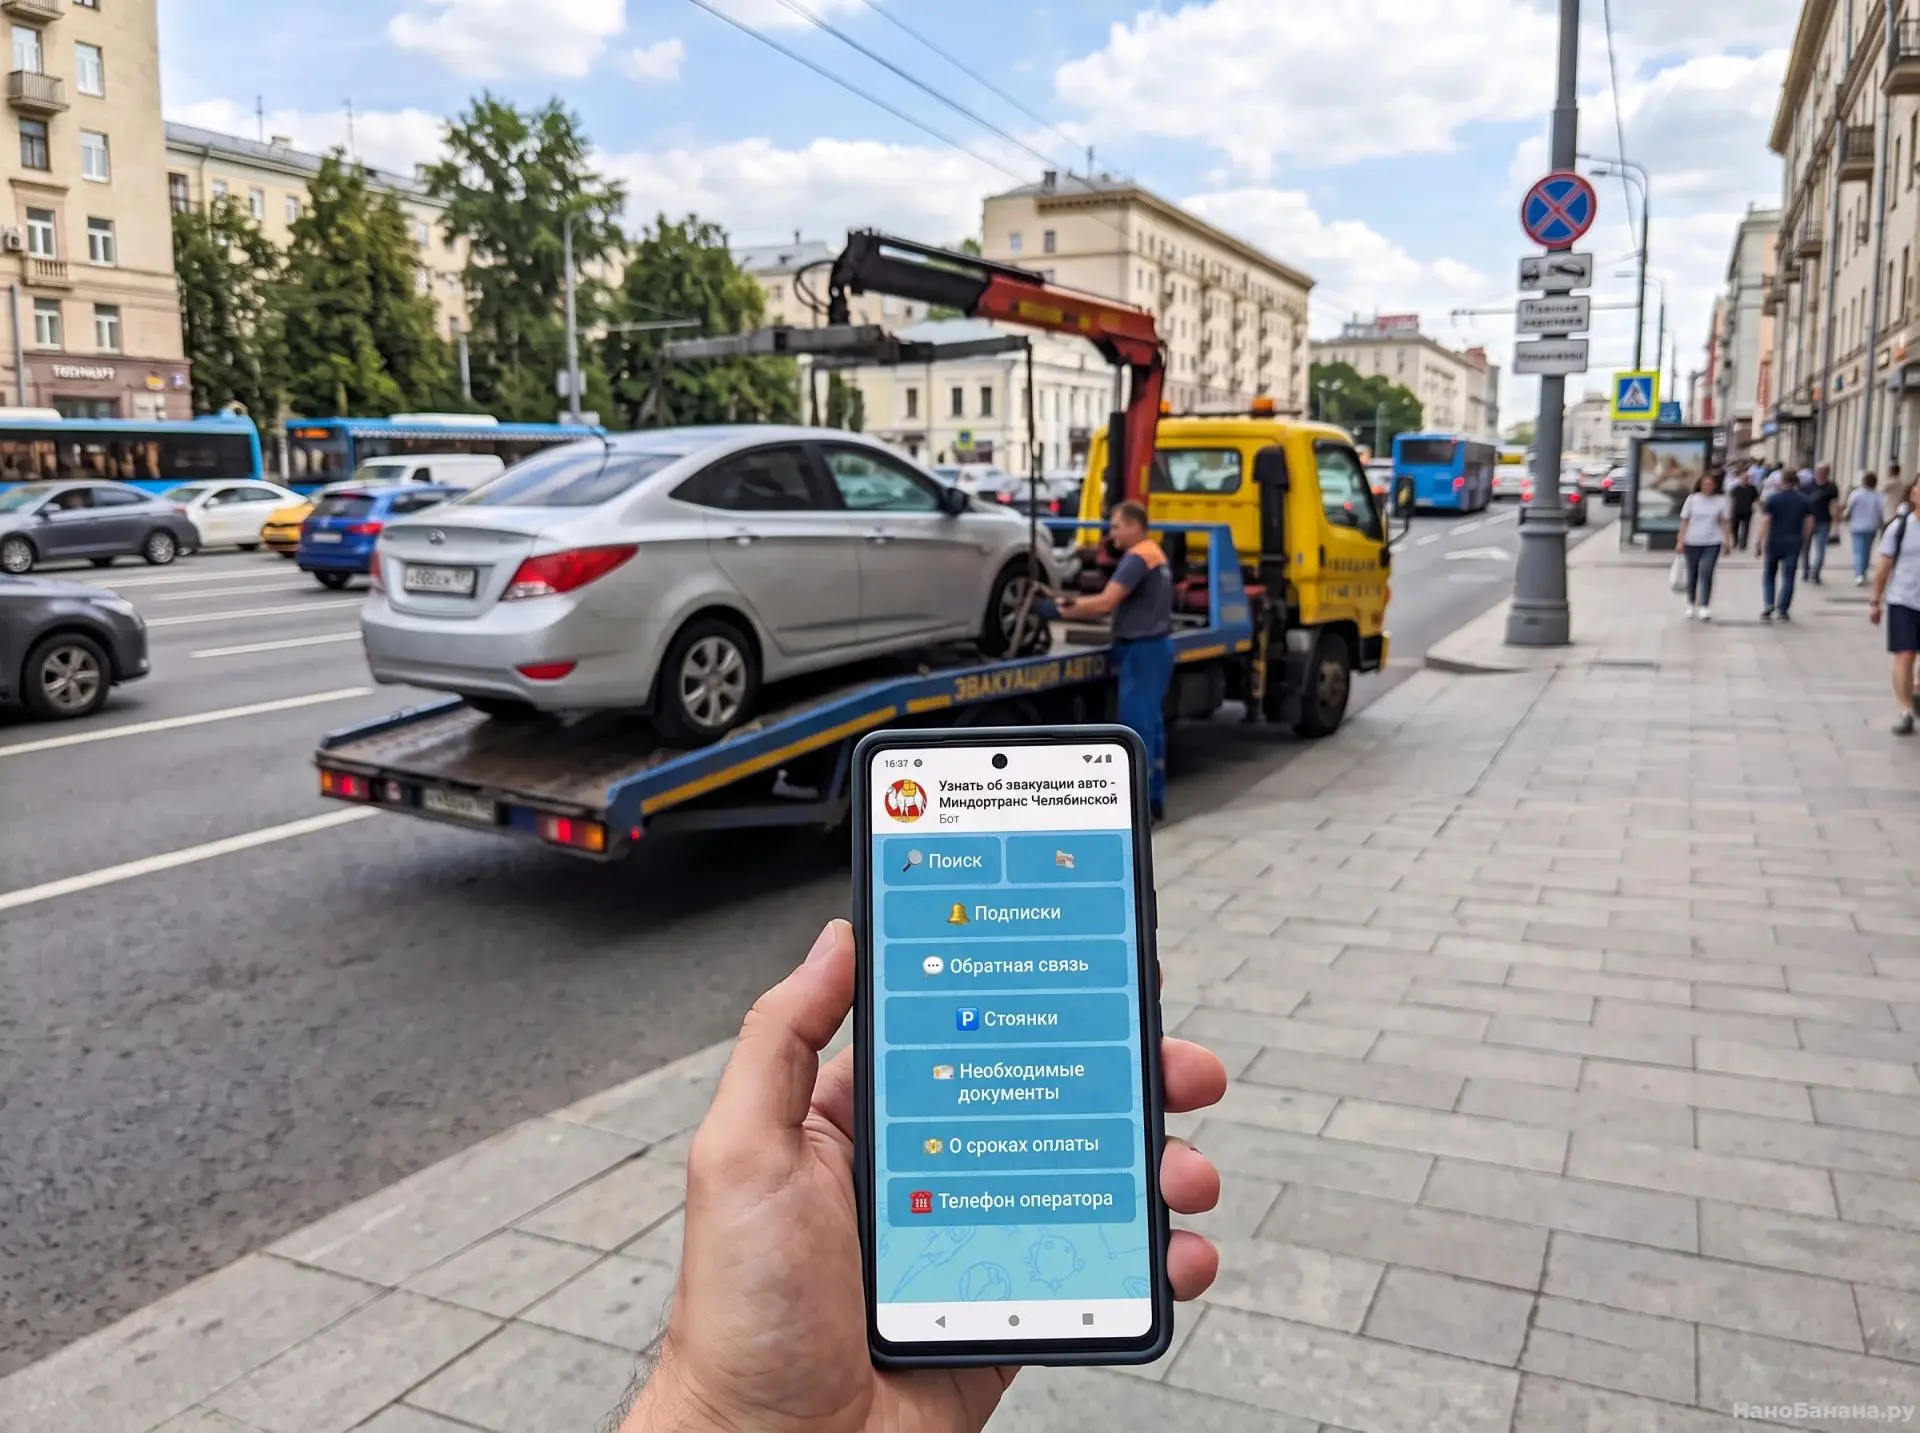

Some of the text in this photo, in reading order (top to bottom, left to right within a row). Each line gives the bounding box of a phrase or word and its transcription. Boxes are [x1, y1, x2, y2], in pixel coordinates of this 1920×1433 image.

[884, 759, 909, 768] 16:37
[938, 780, 984, 792] Узнать
[987, 778, 1003, 791] об
[1077, 779, 1108, 789] авто
[939, 792, 1118, 810] Миндортранс Челябинской
[939, 813, 960, 824] Бот
[929, 853, 983, 869] Поиск
[975, 905, 1061, 922] Подписки
[950, 957, 1089, 977] Обратная связь
[984, 1011, 1058, 1027] Стоянки
[960, 1062, 1085, 1081] Необходимые
[957, 1086, 1059, 1105] документы
[949, 1137, 1099, 1157] О сроках оплаты
[937, 1191, 1113, 1212] Телефон оператора
